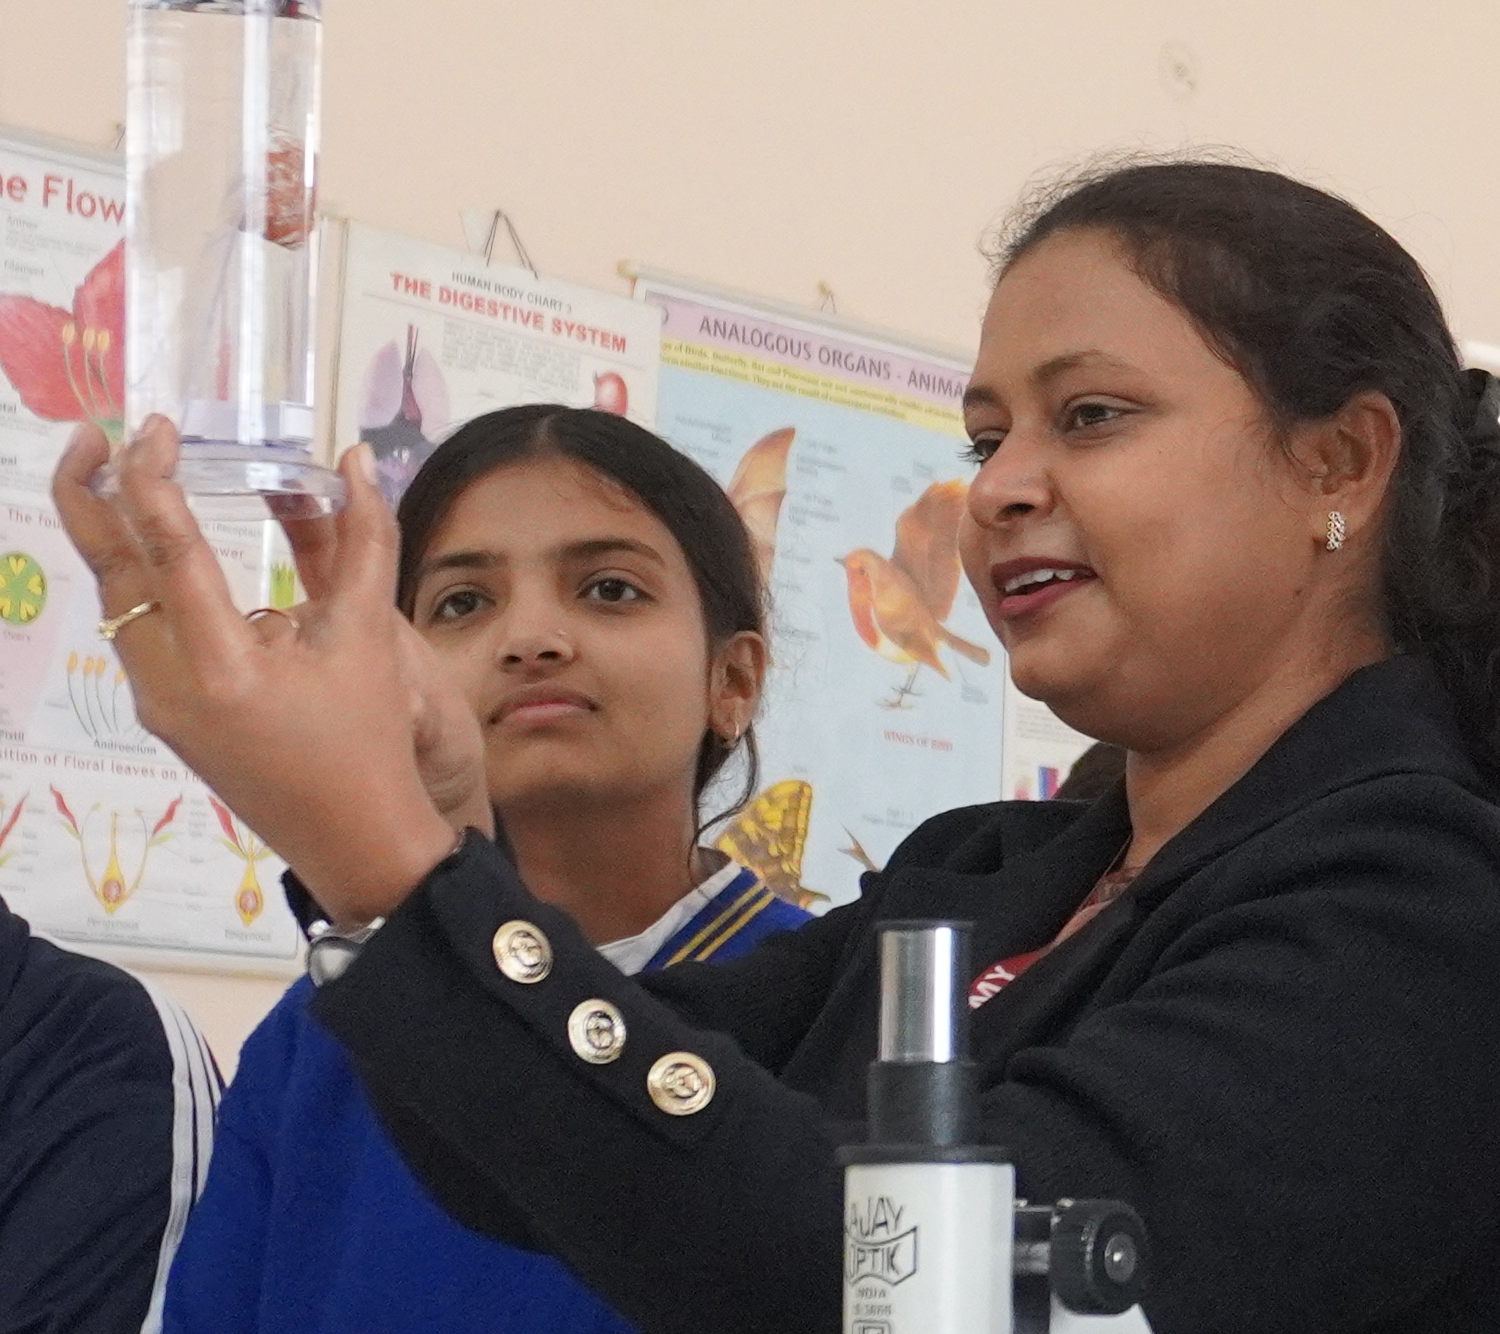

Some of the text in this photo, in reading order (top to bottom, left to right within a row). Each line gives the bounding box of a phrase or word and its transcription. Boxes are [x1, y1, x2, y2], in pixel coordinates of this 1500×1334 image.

[390, 271, 628, 354] THE DIGESTIVE SYSTEM
[451, 271, 491, 291] HUMAN
[494, 284, 524, 301] BODY
[527, 291, 564, 310] CHART
[699, 315, 812, 361] ANALOGOUS
[818, 346, 891, 380] ORGANS
[44, 754, 57, 765] of
[64, 755, 104, 773] Floral
[111, 762, 156, 778] leaves
[161, 769, 177, 781] on
